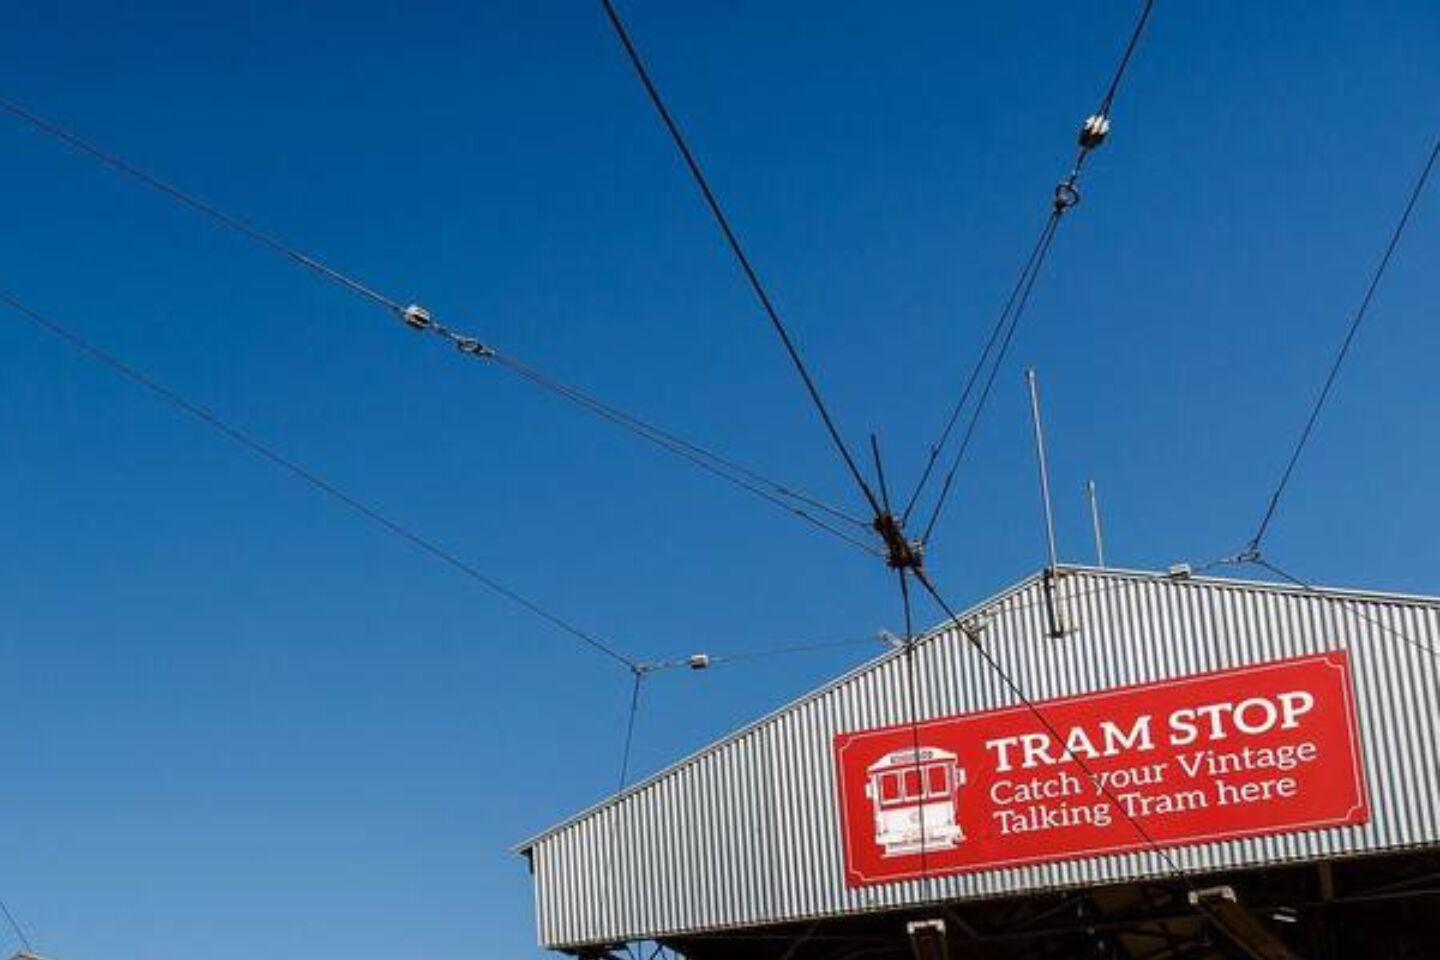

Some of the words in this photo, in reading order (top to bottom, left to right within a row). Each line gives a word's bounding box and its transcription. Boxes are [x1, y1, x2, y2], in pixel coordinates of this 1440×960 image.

[986, 714, 1155, 772] TRAM
[1168, 691, 1314, 745] STOP
[990, 771, 1082, 805] Catch
[1089, 764, 1168, 797] your
[1176, 741, 1317, 778] Vintage
[992, 801, 1112, 835] Talking
[1117, 790, 1208, 818] Tram
[1216, 777, 1297, 806] here
